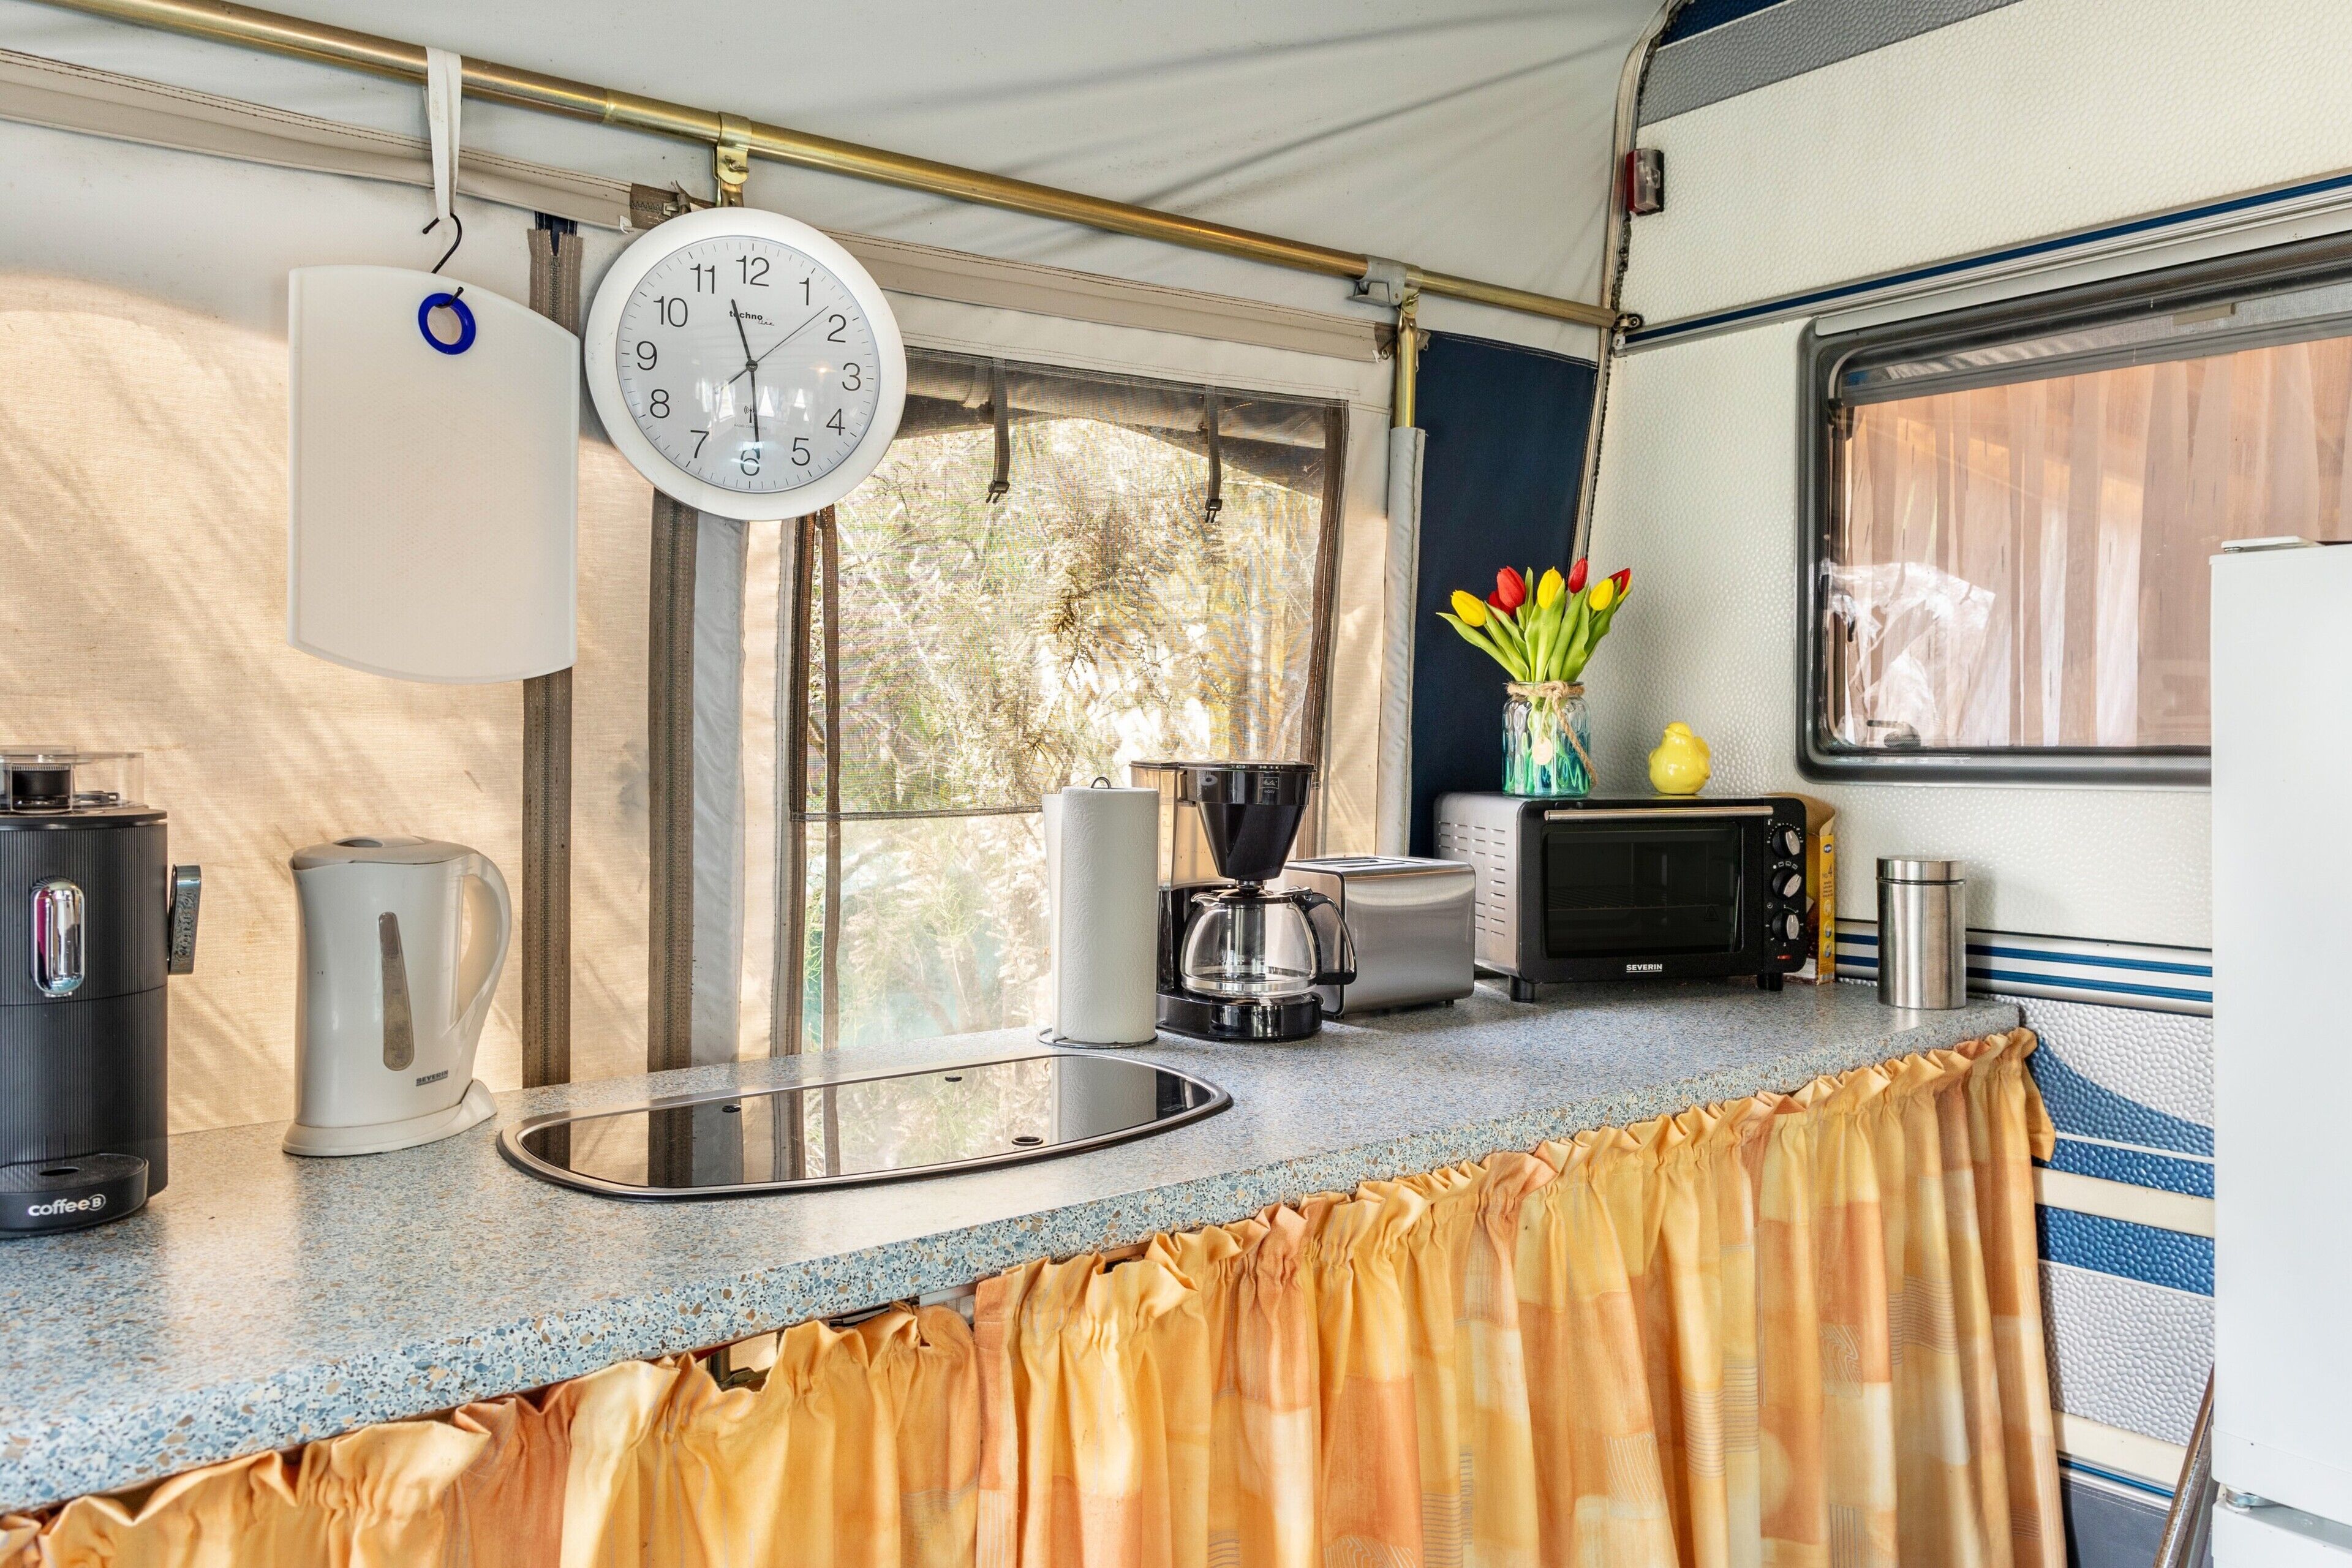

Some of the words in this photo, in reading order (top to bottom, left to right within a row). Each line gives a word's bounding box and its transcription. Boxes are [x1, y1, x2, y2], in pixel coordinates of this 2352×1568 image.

[690, 263, 715, 295] 11
[736, 255, 769, 287] 12
[799, 277, 810, 306] 1
[653, 295, 688, 328] 10
[827, 314, 846, 343] 2
[636, 341, 657, 371] 9
[842, 362, 861, 391] 3
[649, 389, 670, 419] 8
[826, 408, 846, 436] 4
[690, 429, 709, 459] 7
[791, 437, 810, 466] 5
[741, 448, 760, 476] 6
[417, 1070, 448, 1084] SEVERIN
